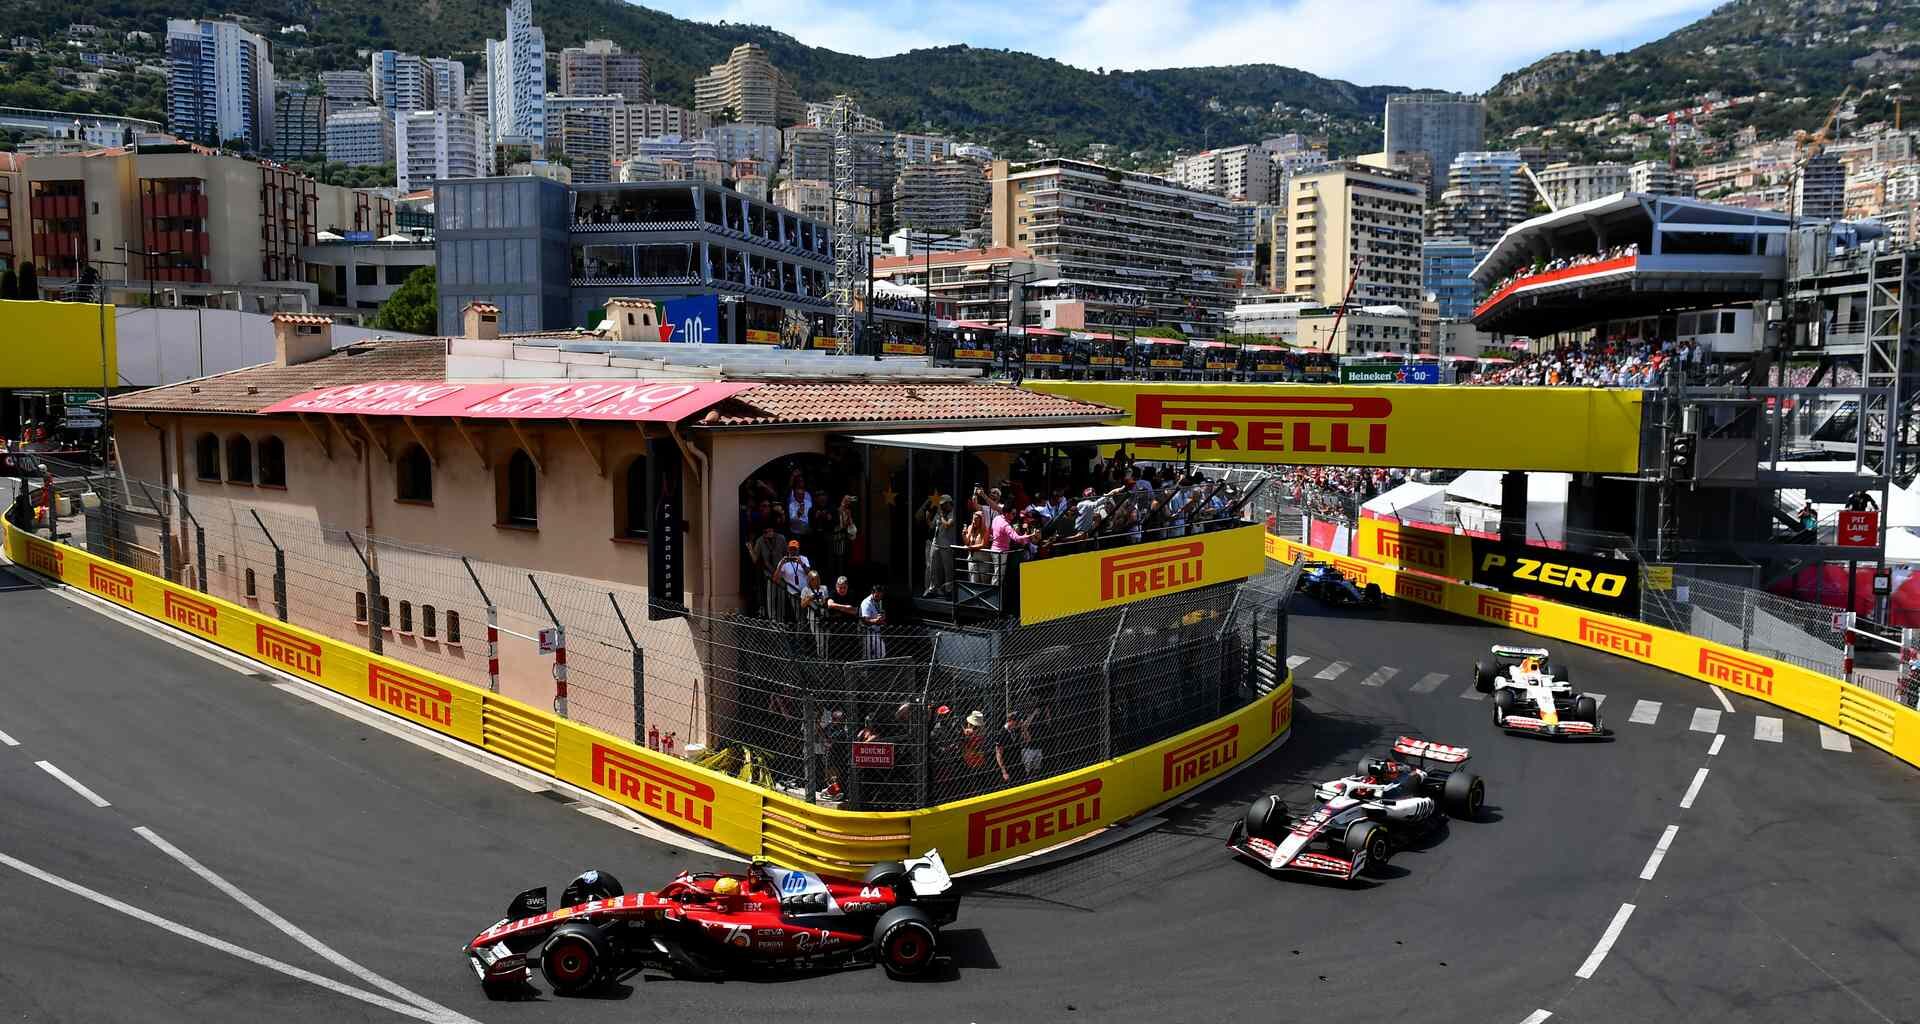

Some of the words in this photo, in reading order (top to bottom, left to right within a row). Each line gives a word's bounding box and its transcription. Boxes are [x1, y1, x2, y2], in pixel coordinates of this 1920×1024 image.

[498, 384, 694, 403] CASINO
[1349, 371, 1392, 381] Heineken
[1847, 523, 1869, 532] LANE
[1851, 516, 1865, 524] PIT
[25, 540, 64, 577] PIRELLI
[1377, 528, 1444, 569] PIRELLI
[89, 563, 134, 604] PIRELLI
[1101, 541, 1204, 601] PIRELLI
[1395, 573, 1442, 606] PIRELLI
[1481, 553, 1506, 572] P
[1512, 557, 1628, 598] ZERO
[164, 590, 217, 637] PIRELLI
[1477, 594, 1539, 629] PIRELLI
[256, 623, 322, 677] PIRELLI
[1579, 616, 1653, 658] PIRELLI
[1698, 647, 1774, 696] PIRELLI
[368, 663, 452, 727] PIRELLI
[1163, 724, 1240, 793] PIRELLI
[592, 743, 716, 830] PIRELLI
[968, 778, 1104, 860] PIRELLI
[526, 897, 545, 905] aws
[784, 872, 805, 893] hp
[860, 886, 881, 899] 44
[724, 924, 753, 947] 75
